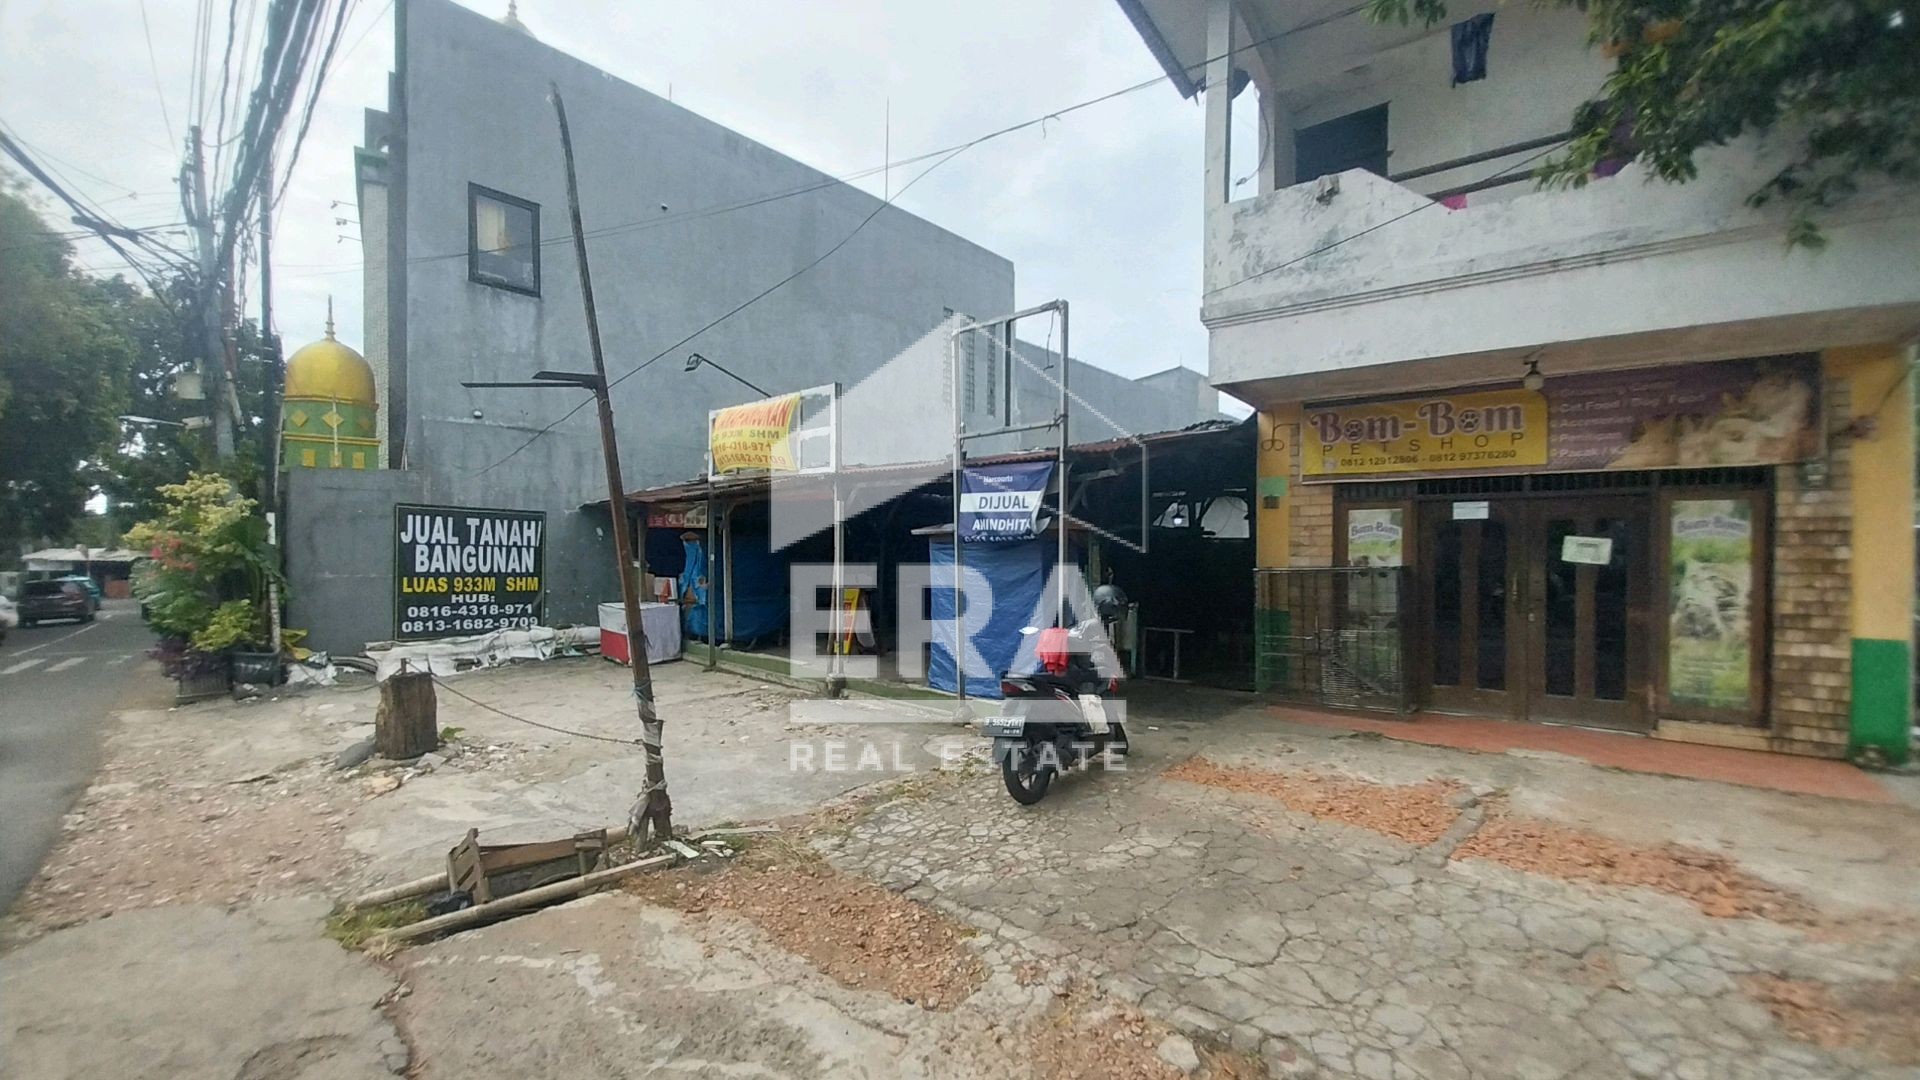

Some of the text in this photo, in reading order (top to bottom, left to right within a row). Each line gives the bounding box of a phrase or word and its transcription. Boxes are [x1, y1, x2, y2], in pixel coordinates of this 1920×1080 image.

[748, 429, 780, 440] SHM
[1340, 457, 1366, 467] 0812
[978, 495, 1029, 510] DIJUAL
[400, 514, 542, 547] JUAL TANAH/
[415, 544, 535, 573] BANGUNAN
[402, 576, 539, 593] LUAS 933M SHM
[451, 594, 496, 604] HUB:
[407, 603, 533, 618] 0816-4318-971
[401, 616, 538, 633] 0813-1682-9709
